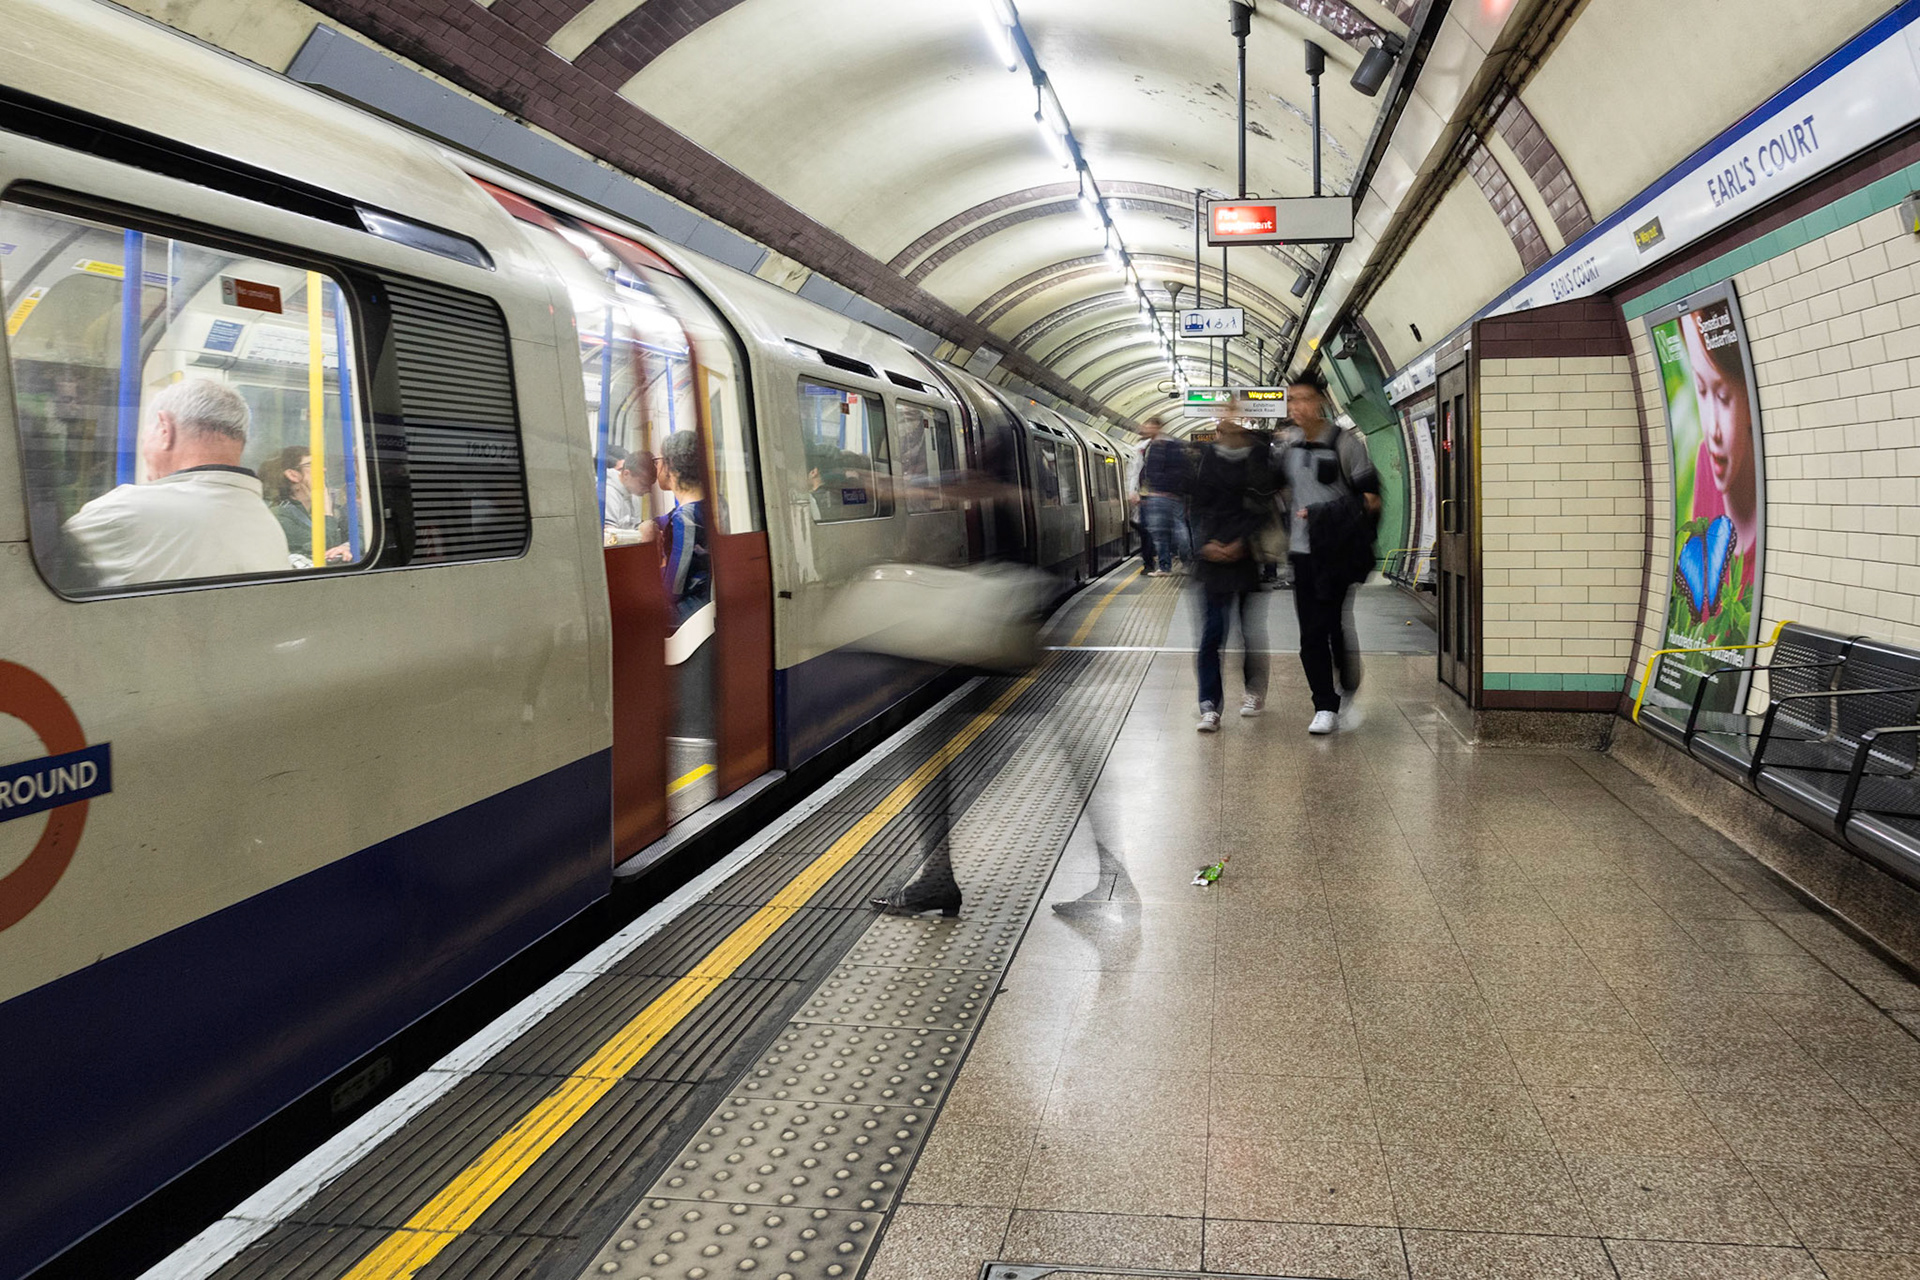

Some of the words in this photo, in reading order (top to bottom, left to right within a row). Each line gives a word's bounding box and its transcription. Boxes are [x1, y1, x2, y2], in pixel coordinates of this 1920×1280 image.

[1707, 156, 1756, 208] EARL'S
[1758, 114, 1819, 177] COURT
[1573, 256, 1600, 288] COURT
[1248, 391, 1263, 400] Way
[1263, 391, 1276, 399] out
[0, 760, 98, 810] ROUND
